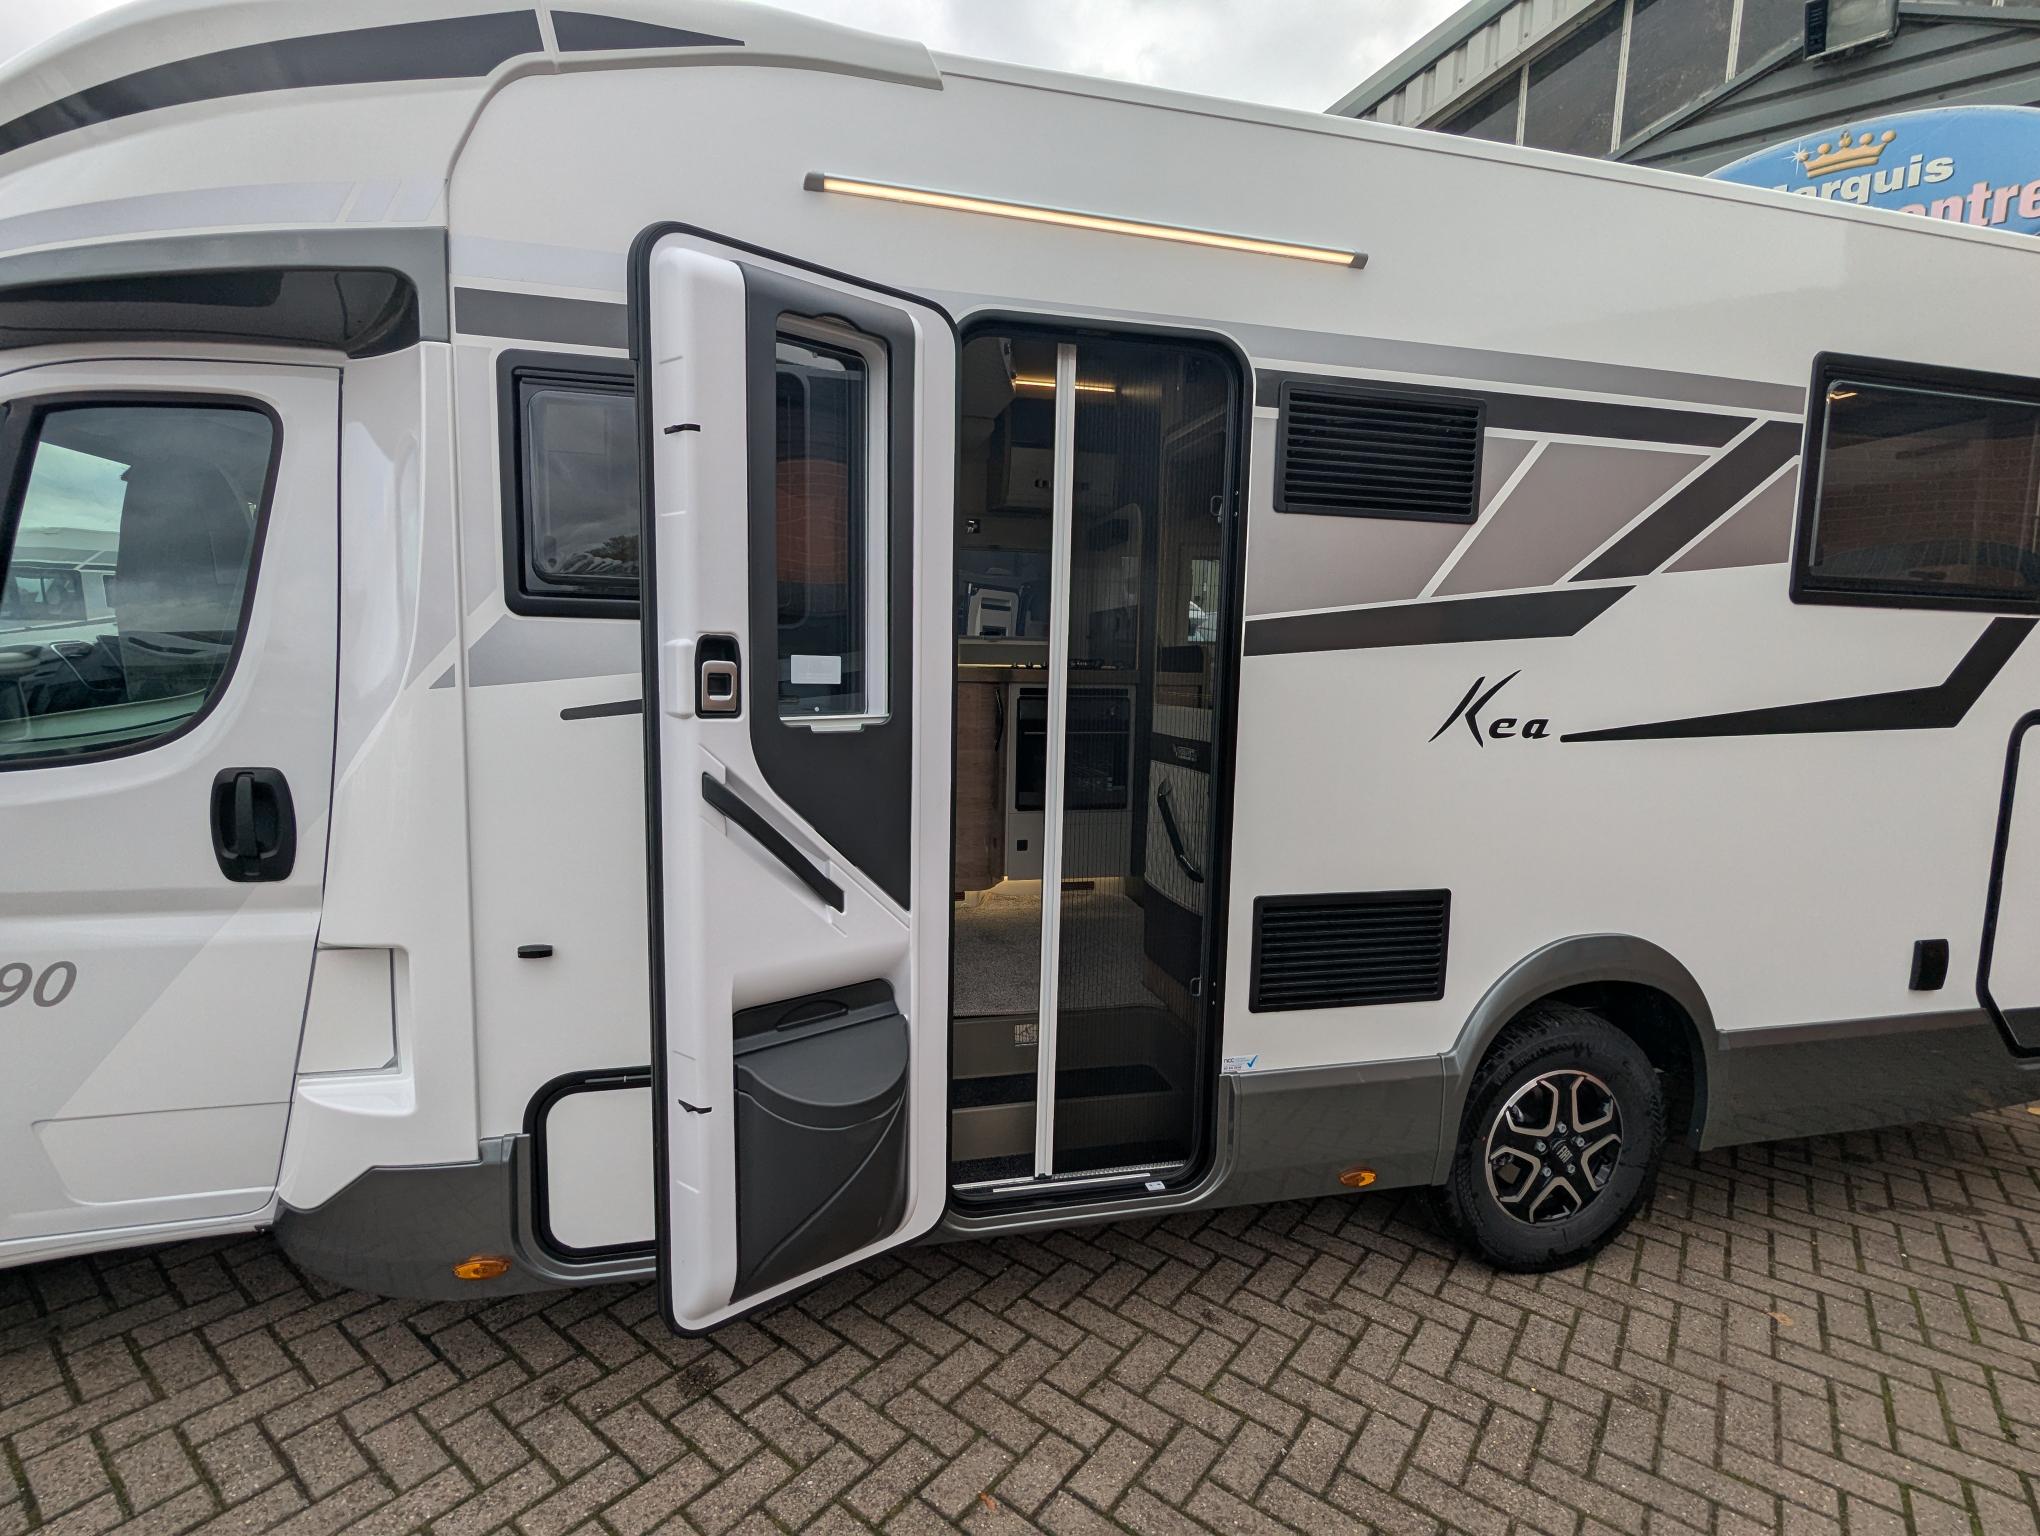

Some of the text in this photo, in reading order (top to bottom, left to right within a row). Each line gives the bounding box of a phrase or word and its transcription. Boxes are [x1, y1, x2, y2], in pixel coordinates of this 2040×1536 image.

[1772, 154, 1955, 204] rquis
[1428, 669, 1551, 748] Kea
[0, 960, 77, 1008] 90
